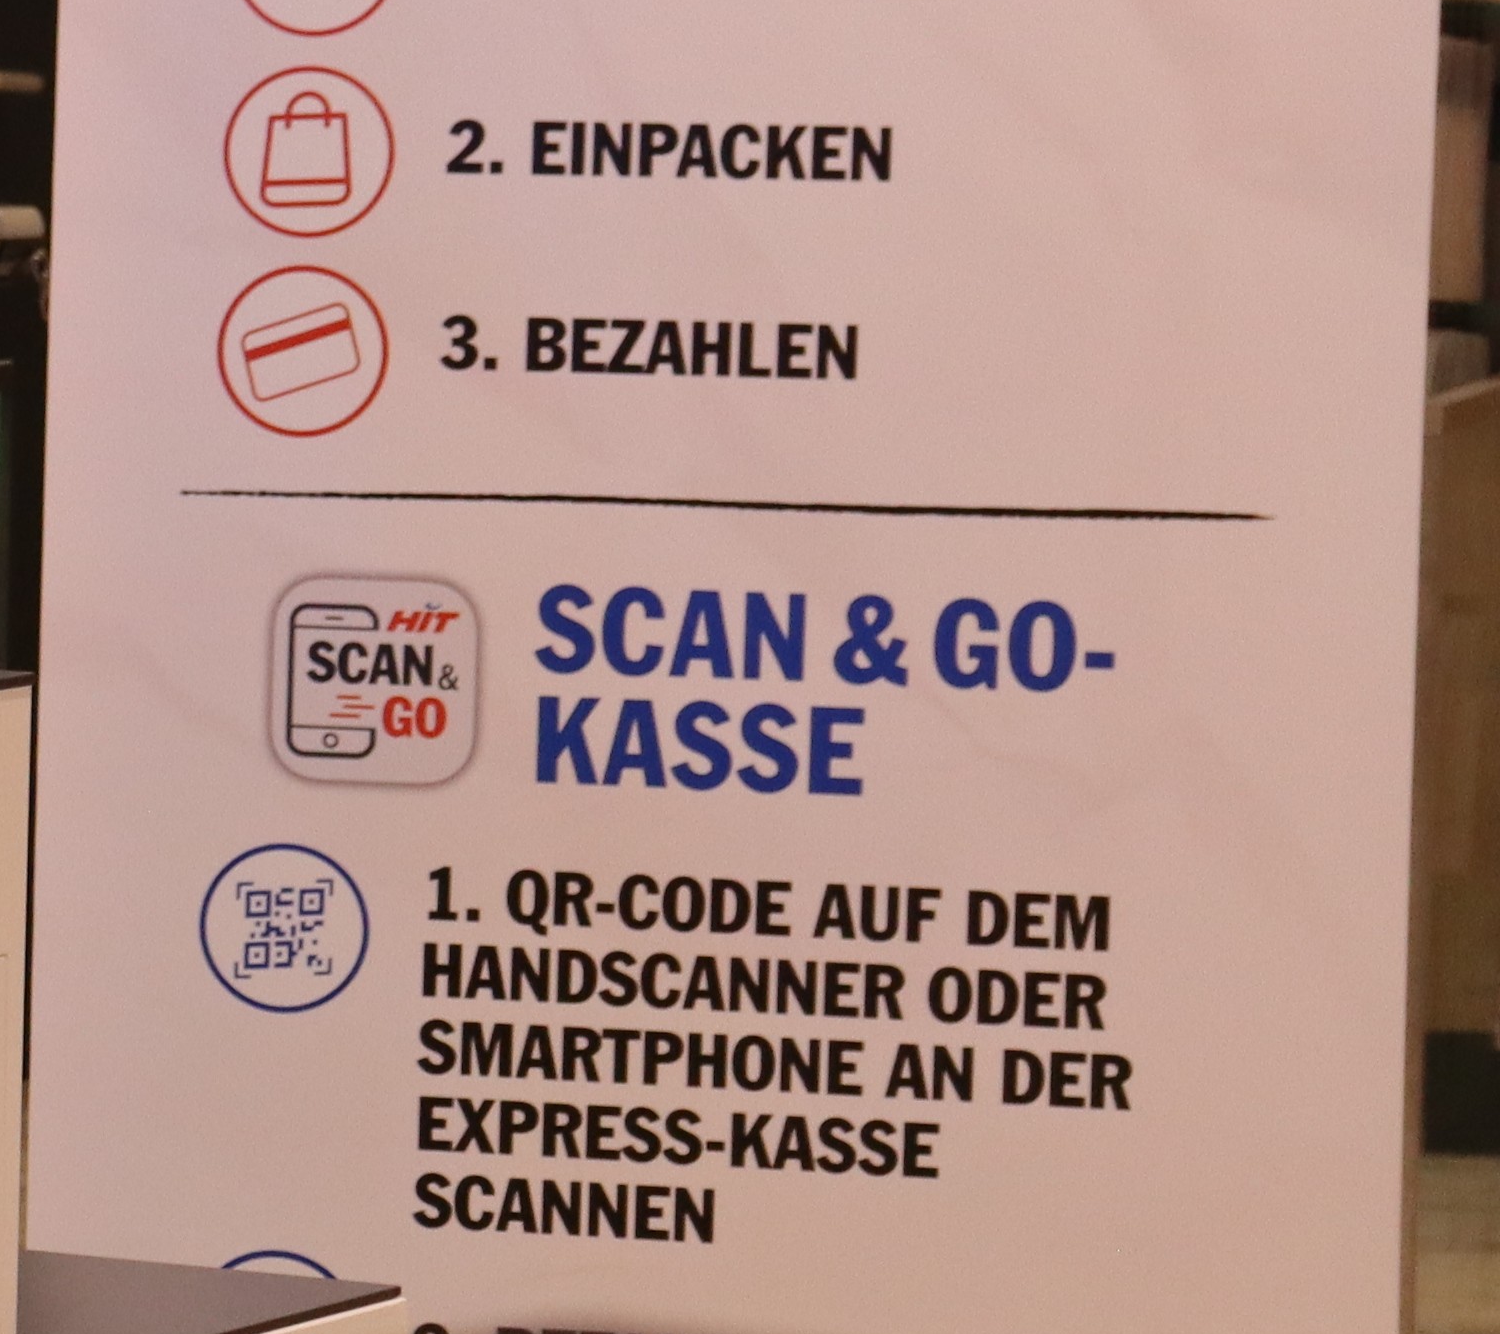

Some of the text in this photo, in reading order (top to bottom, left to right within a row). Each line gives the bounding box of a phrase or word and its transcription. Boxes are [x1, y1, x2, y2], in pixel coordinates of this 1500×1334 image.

[446, 119, 892, 182] 2. EINPACKEN
[441, 315, 858, 380] 3. BEZAHLEN
[387, 602, 460, 633] HIT
[535, 584, 1115, 692] SCAN & GO-
[307, 640, 459, 691] SCAN &
[383, 695, 447, 739] GO
[536, 696, 865, 796] KASSE
[428, 866, 1110, 951] 1. QR-CODE AUF DEM
[422, 942, 1107, 1030] HANDSCANNER ODER
[417, 1019, 1133, 1111] SMARTPHONE AN DER
[416, 1096, 940, 1186] EXPRESS-KASSE
[413, 1173, 715, 1243] SCANNEN
